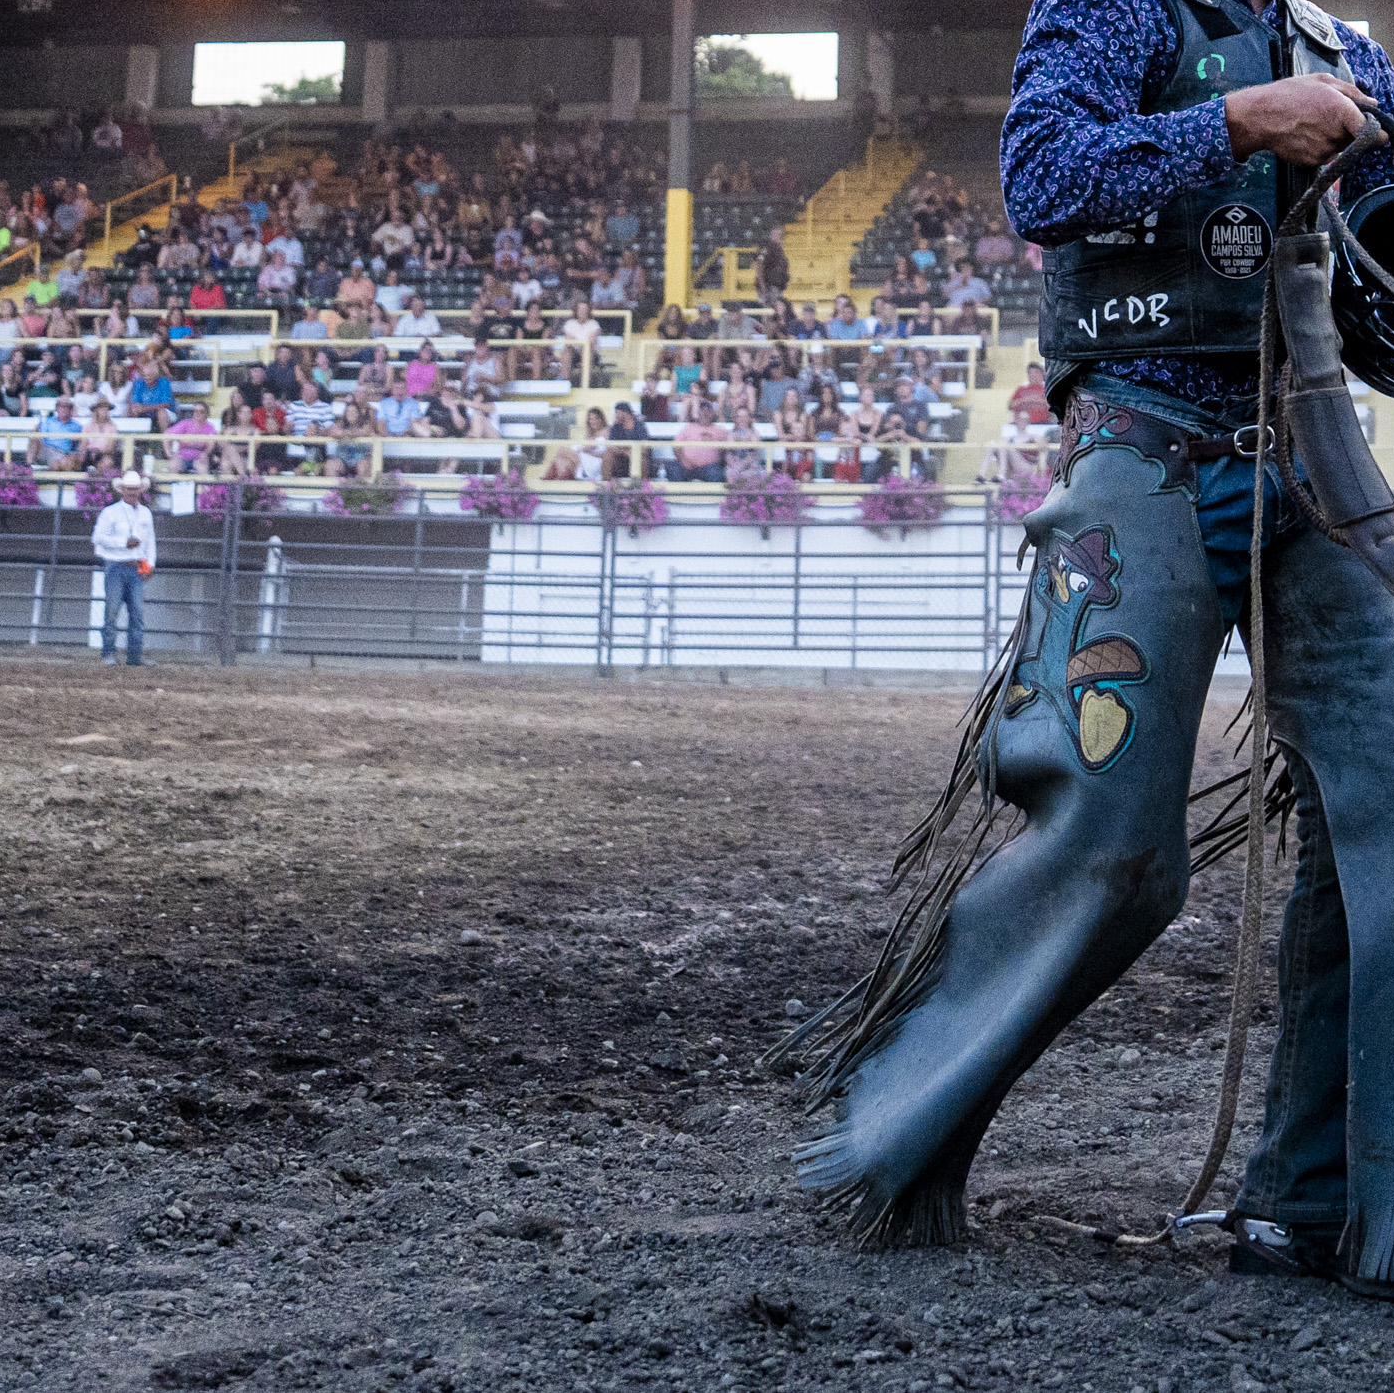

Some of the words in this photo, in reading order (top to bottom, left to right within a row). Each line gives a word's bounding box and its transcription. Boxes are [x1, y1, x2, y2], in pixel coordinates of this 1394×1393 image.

[1212, 225, 1262, 244] AMADEU
[1211, 245, 1242, 257] CAMPOS
[1244, 245, 1263, 257] SILVA
[1232, 259, 1256, 267] COWBOY
